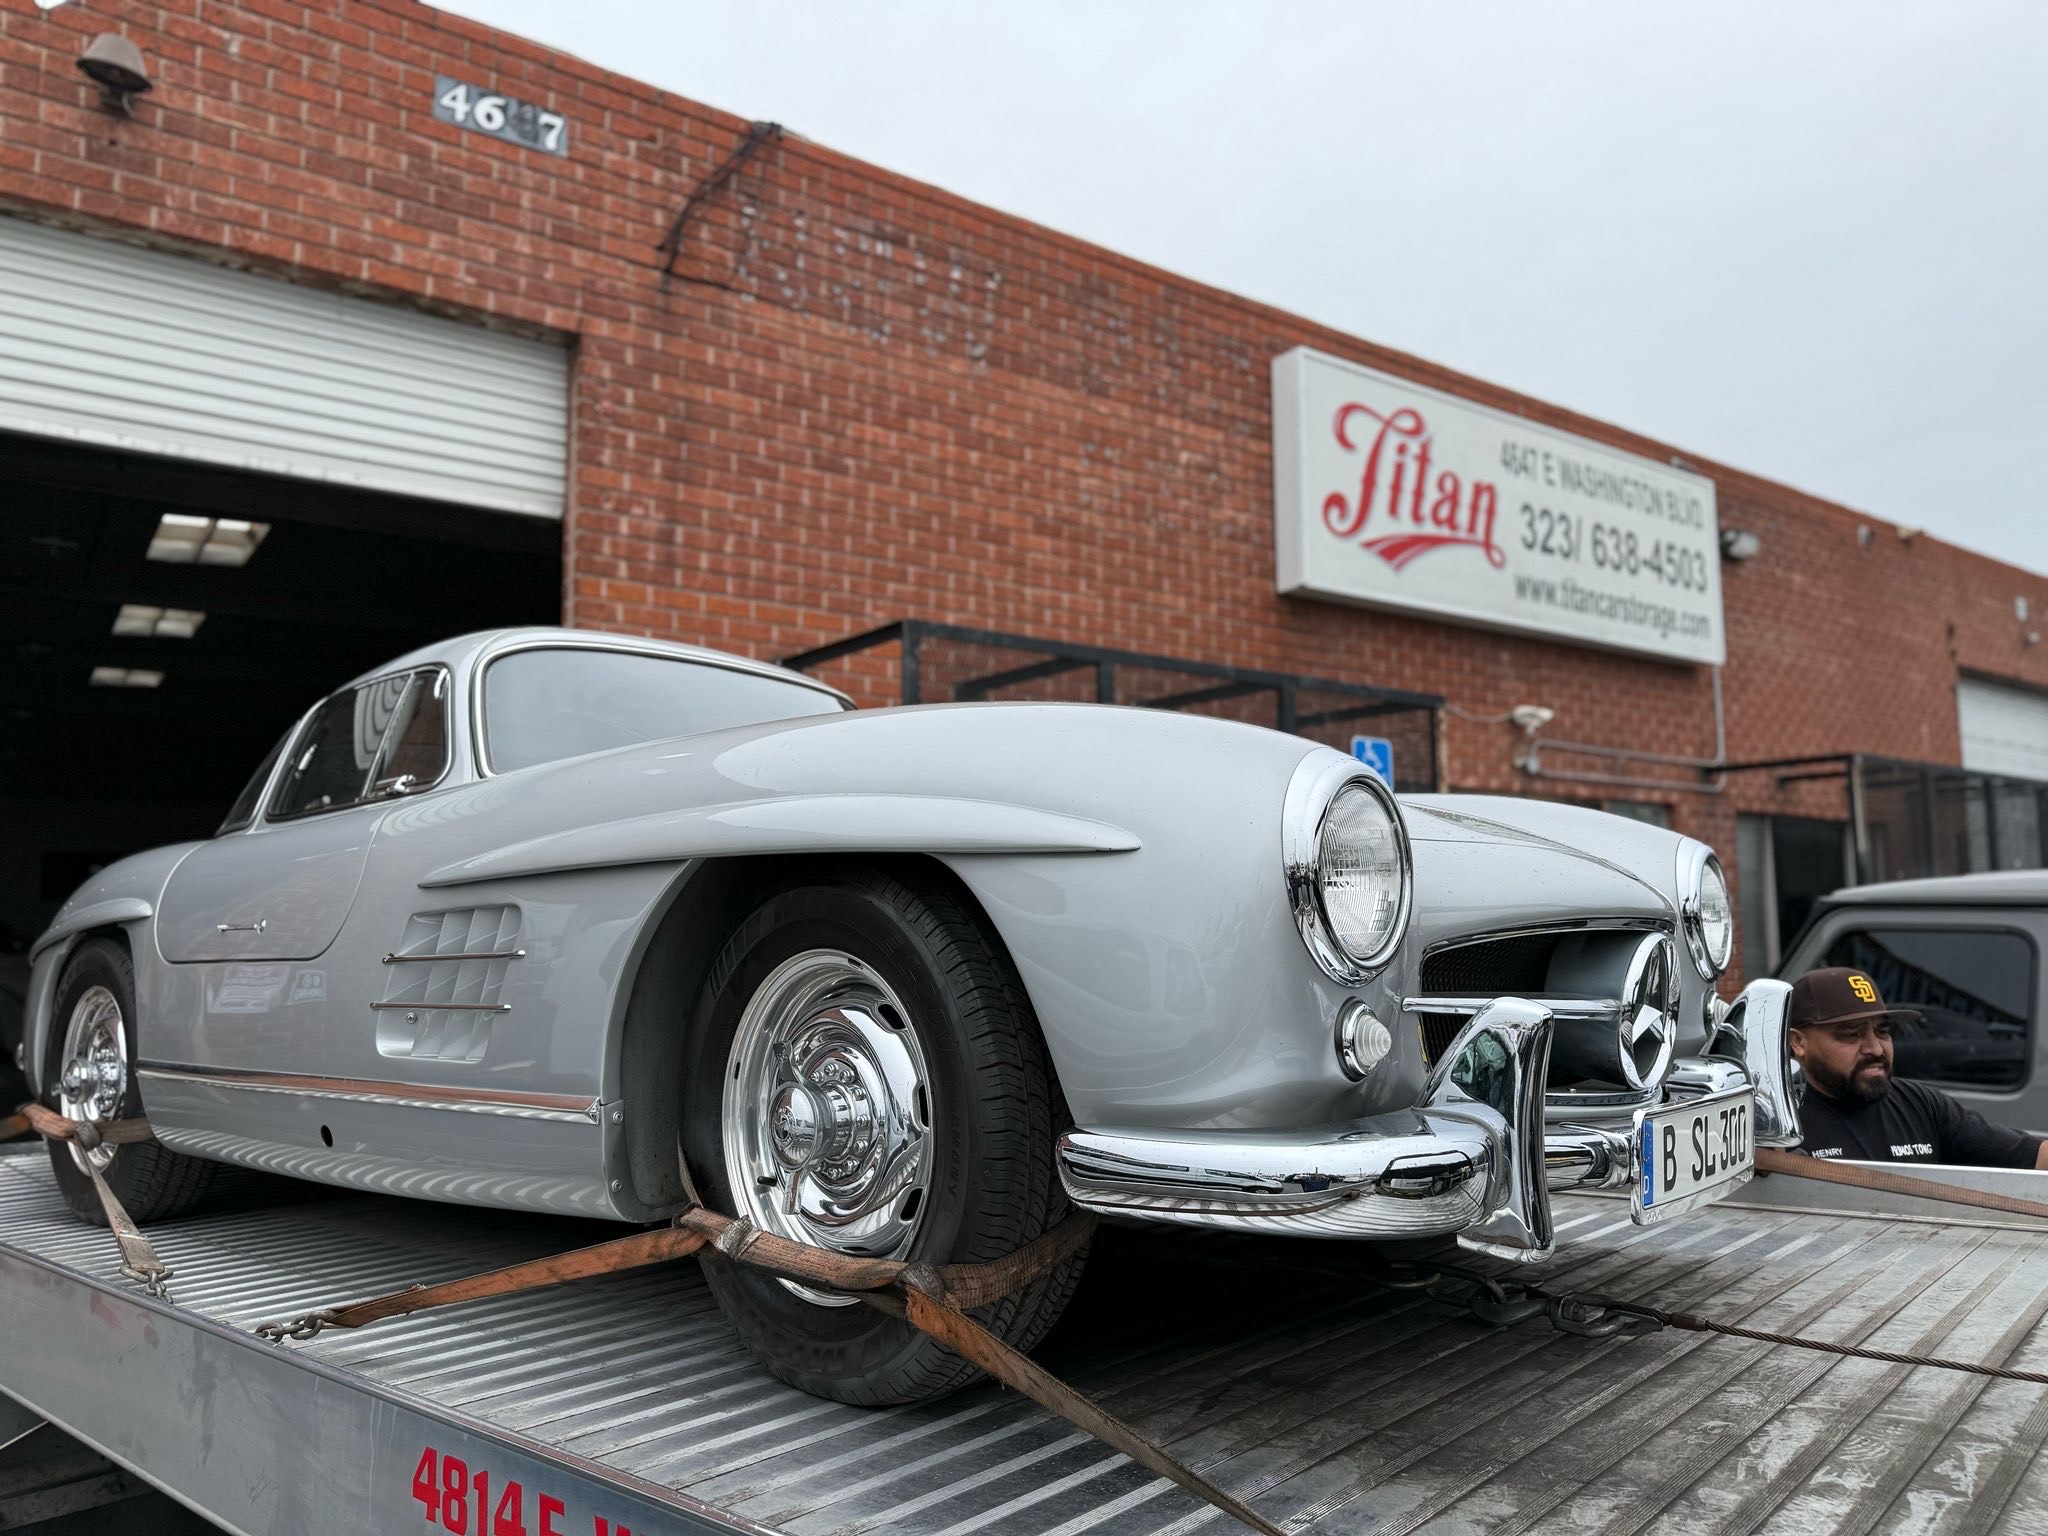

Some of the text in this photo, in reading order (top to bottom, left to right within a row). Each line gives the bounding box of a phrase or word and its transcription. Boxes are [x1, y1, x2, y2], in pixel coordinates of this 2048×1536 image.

[1323, 402, 1505, 569] Titan
[1543, 452, 1555, 487] E
[1559, 457, 1663, 517] WASHINGTON
[1591, 522, 1707, 595] 638-4503
[1514, 572, 1711, 639] www.titancarstorage.com
[1848, 975, 1876, 1003] SD
[1663, 1105, 1746, 1192] B SL 300
[1812, 1147, 1843, 1159] HENRY
[412, 1446, 527, 1536] 4814
